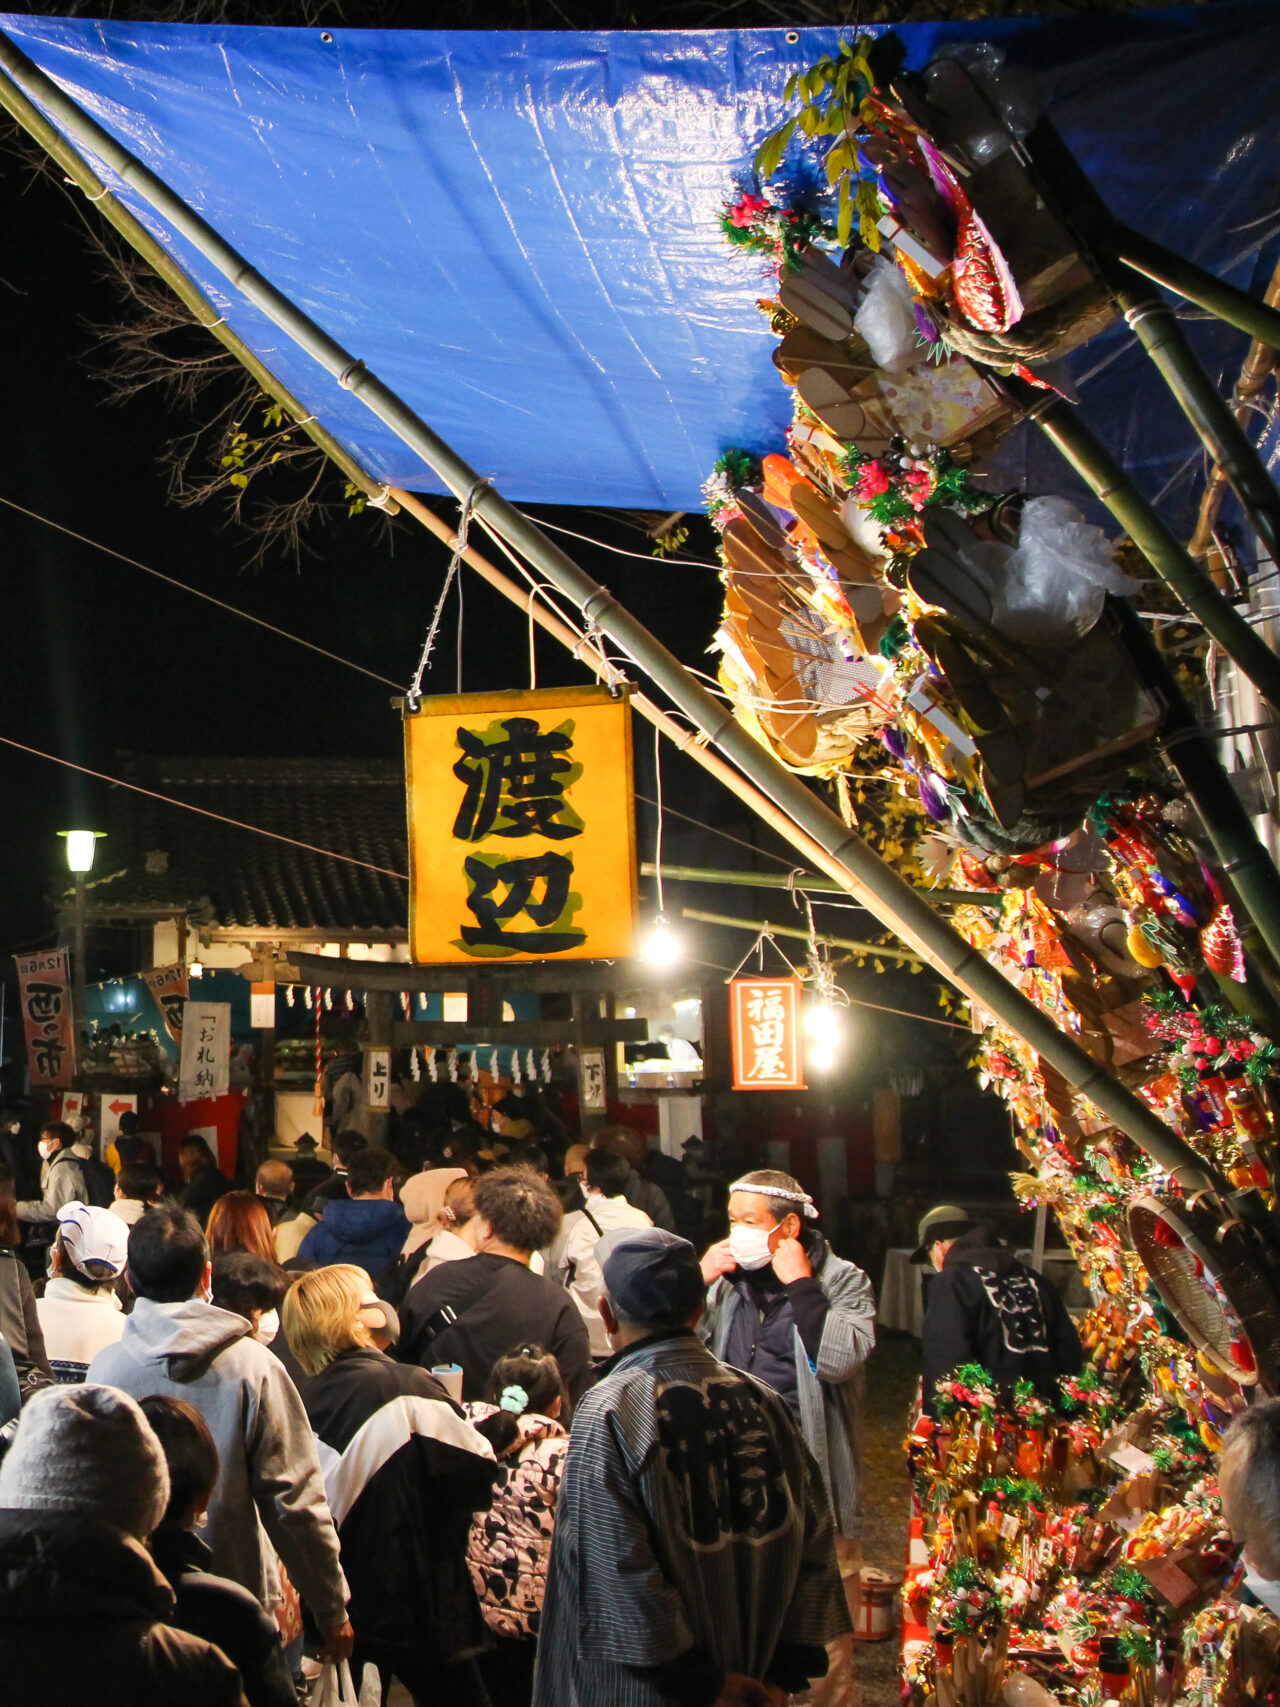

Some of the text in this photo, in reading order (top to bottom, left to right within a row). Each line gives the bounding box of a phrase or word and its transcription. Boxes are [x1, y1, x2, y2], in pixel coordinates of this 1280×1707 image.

[452, 717, 587, 955] 渡辺
[372, 1061, 388, 1099] 上り
[746, 988, 788, 1080] 福田屋
